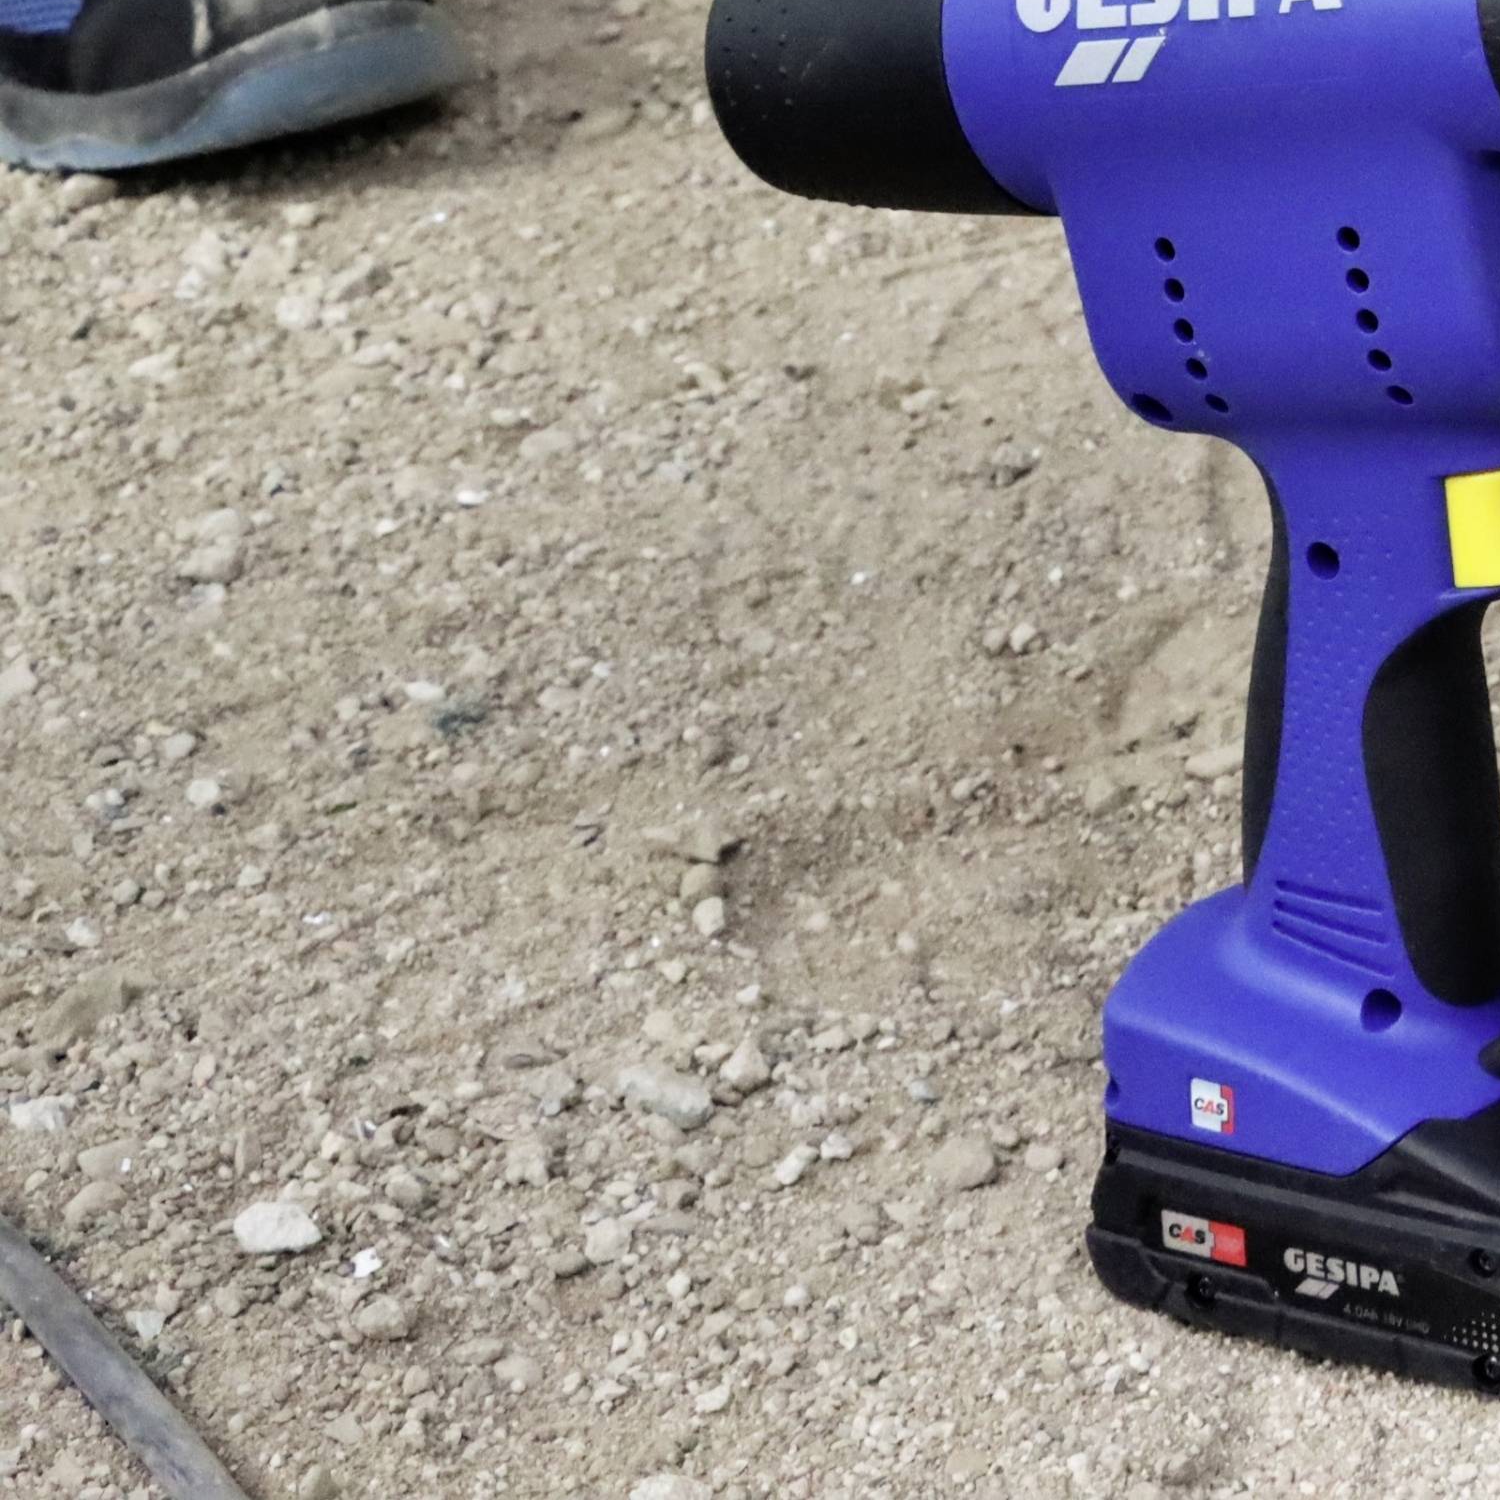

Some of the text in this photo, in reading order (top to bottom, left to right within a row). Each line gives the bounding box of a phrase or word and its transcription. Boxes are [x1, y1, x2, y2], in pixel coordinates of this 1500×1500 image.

[1194, 1097, 1225, 1116] CAS
[1168, 1223, 1206, 1245] CAS
[1283, 1247, 1400, 1297] GESIPA
